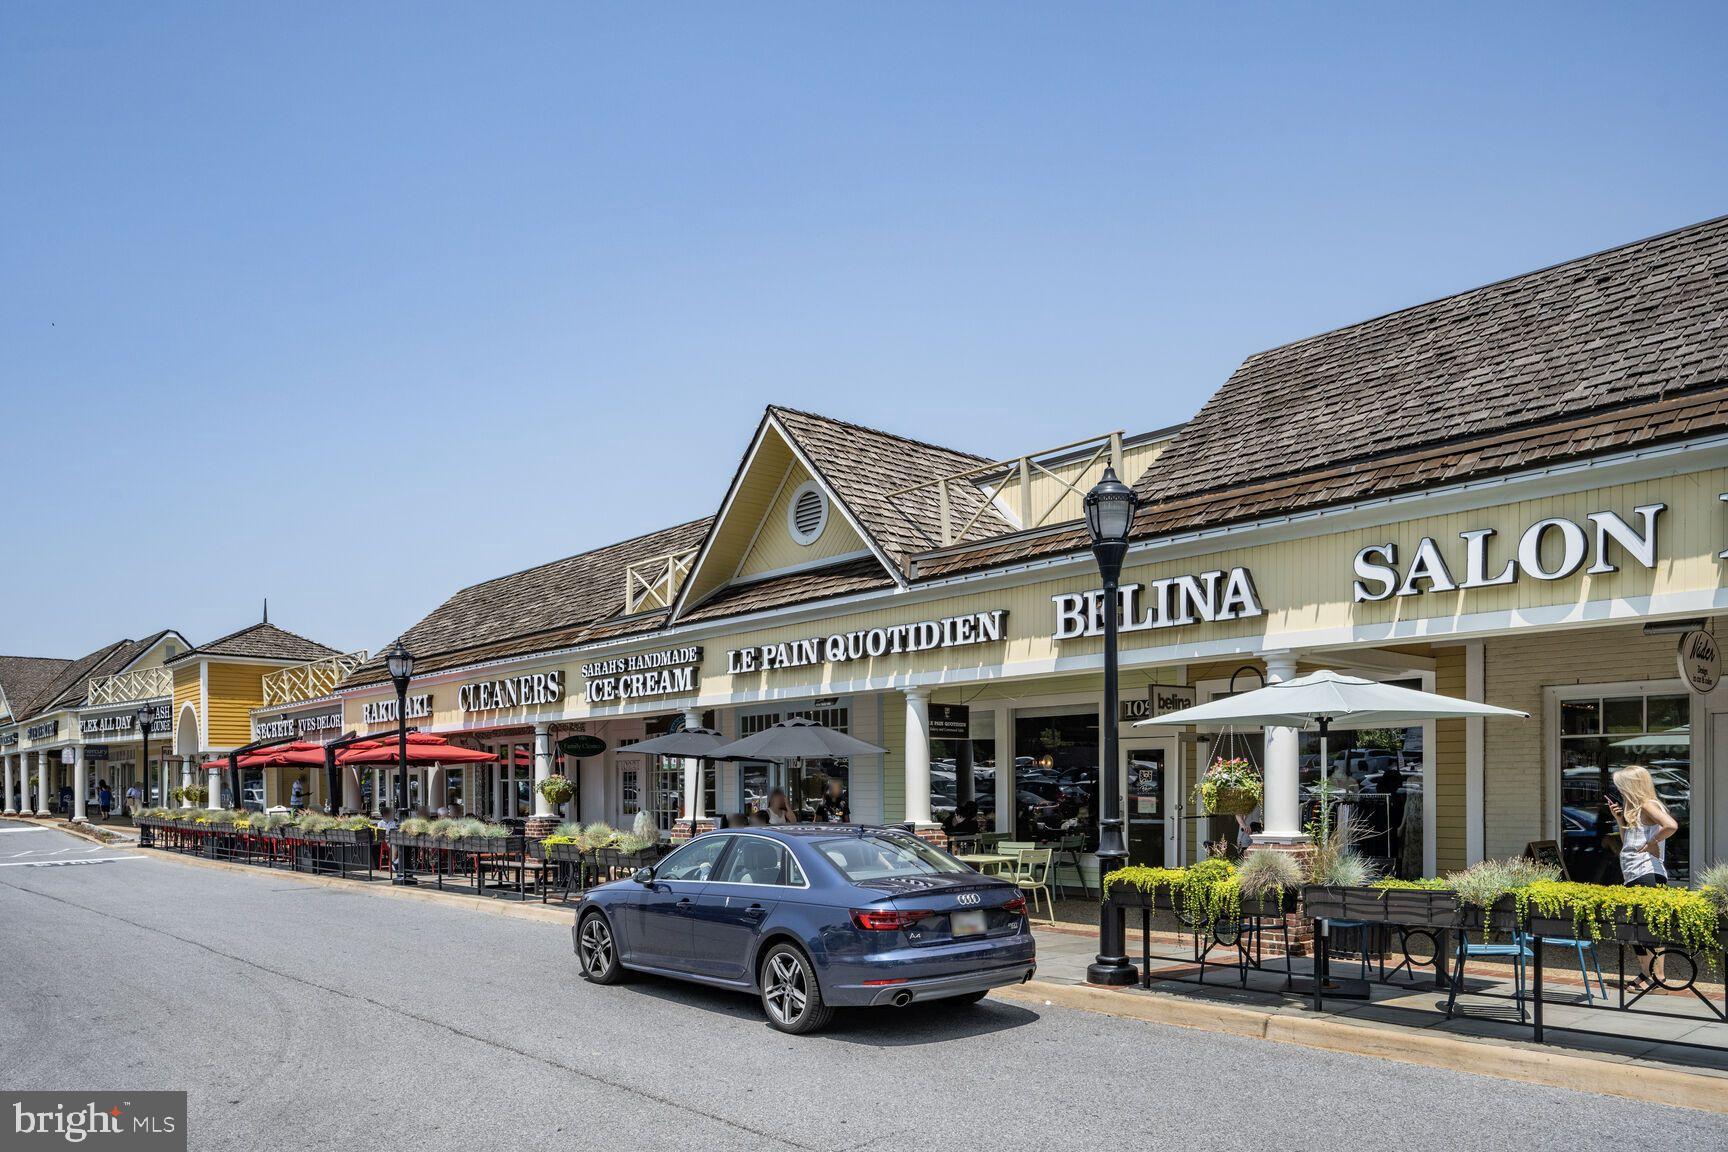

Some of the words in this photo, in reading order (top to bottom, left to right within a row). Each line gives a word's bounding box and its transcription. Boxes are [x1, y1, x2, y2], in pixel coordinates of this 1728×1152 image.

[1353, 503, 1668, 603] SALON
[1051, 567, 1266, 640] BELINA
[727, 647, 757, 675] LE
[761, 637, 822, 670] PAIN
[825, 610, 1007, 663] QUOTIDIEN
[581, 658, 625, 678] SARAH'S
[627, 646, 698, 671] HANDMADE
[458, 670, 560, 712] CLEANERS
[585, 677, 615, 703] ICE
[619, 666, 693, 699] CREAM
[1158, 693, 1191, 710] belina
[100, 717, 114, 731] ALL
[115, 715, 132, 730] DAY
[153, 705, 170, 719] ASH
[298, 717, 316, 732] YVES
